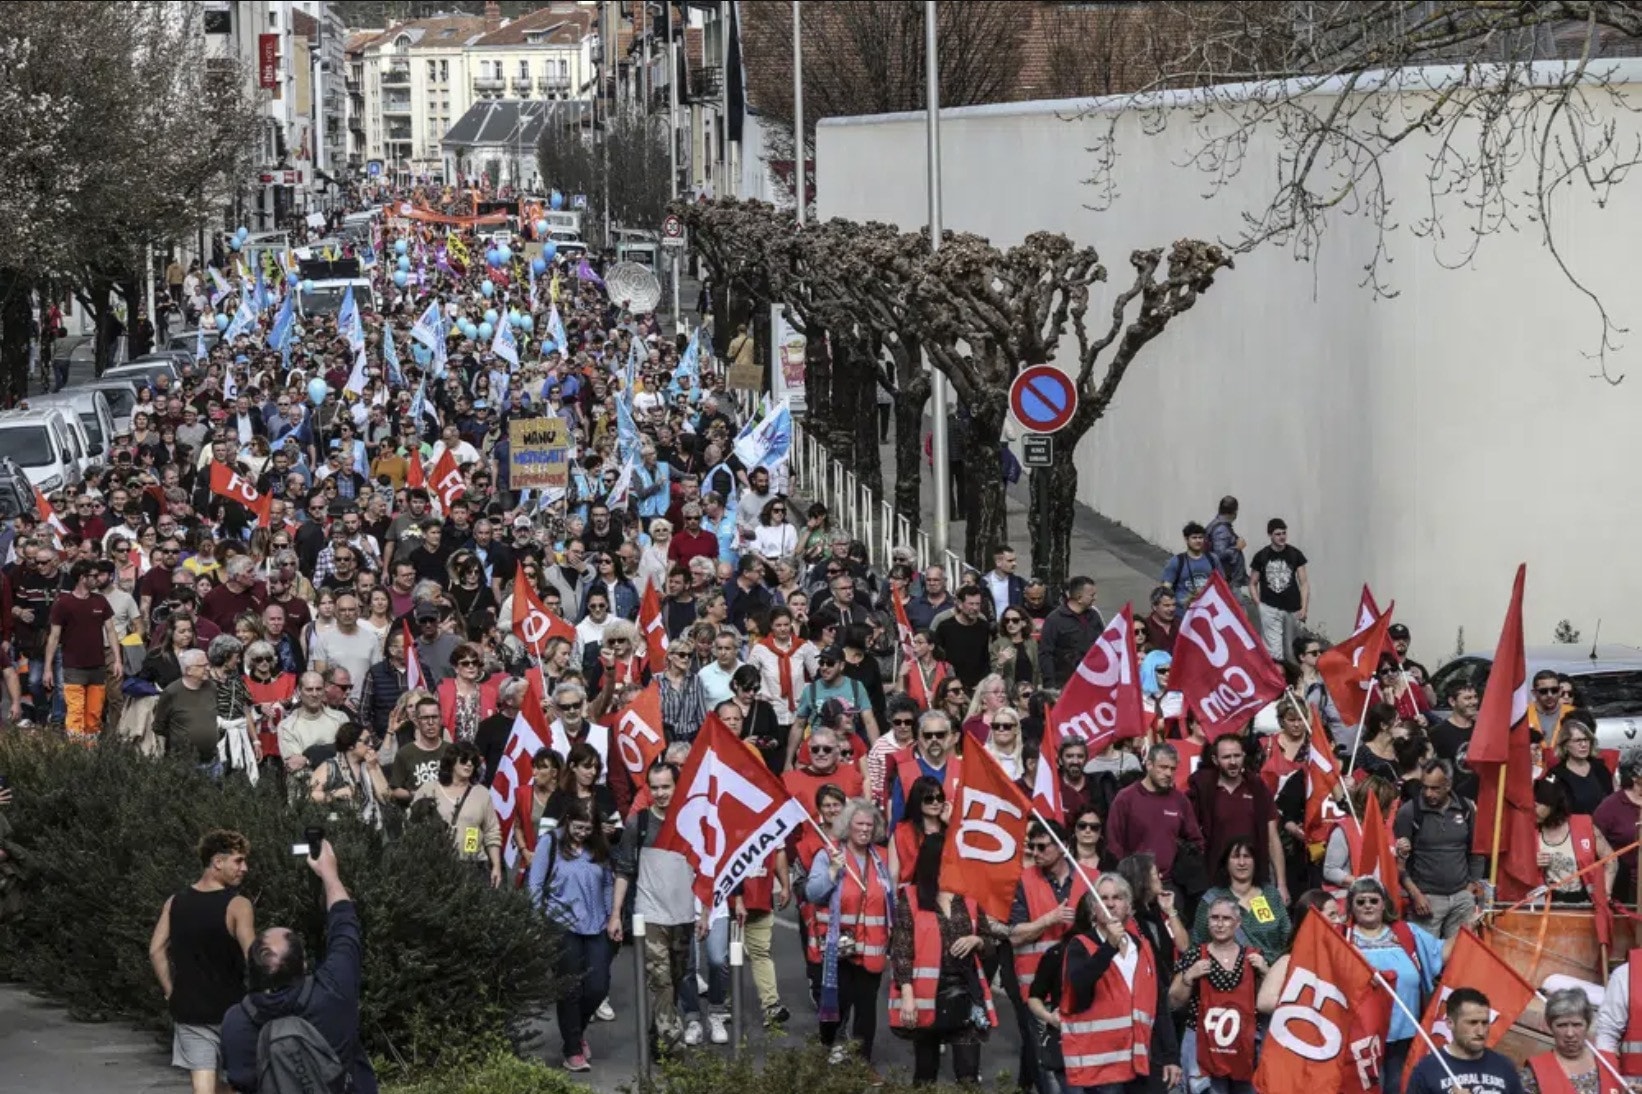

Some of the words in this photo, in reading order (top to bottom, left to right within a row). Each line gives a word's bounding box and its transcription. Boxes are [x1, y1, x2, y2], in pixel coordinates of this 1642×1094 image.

[263, 64, 273, 82] ibis
[523, 431, 557, 445] MANU
[227, 472, 259, 501] FO
[1258, 908, 1270, 919] FO
[1203, 1006, 1241, 1047] FO
